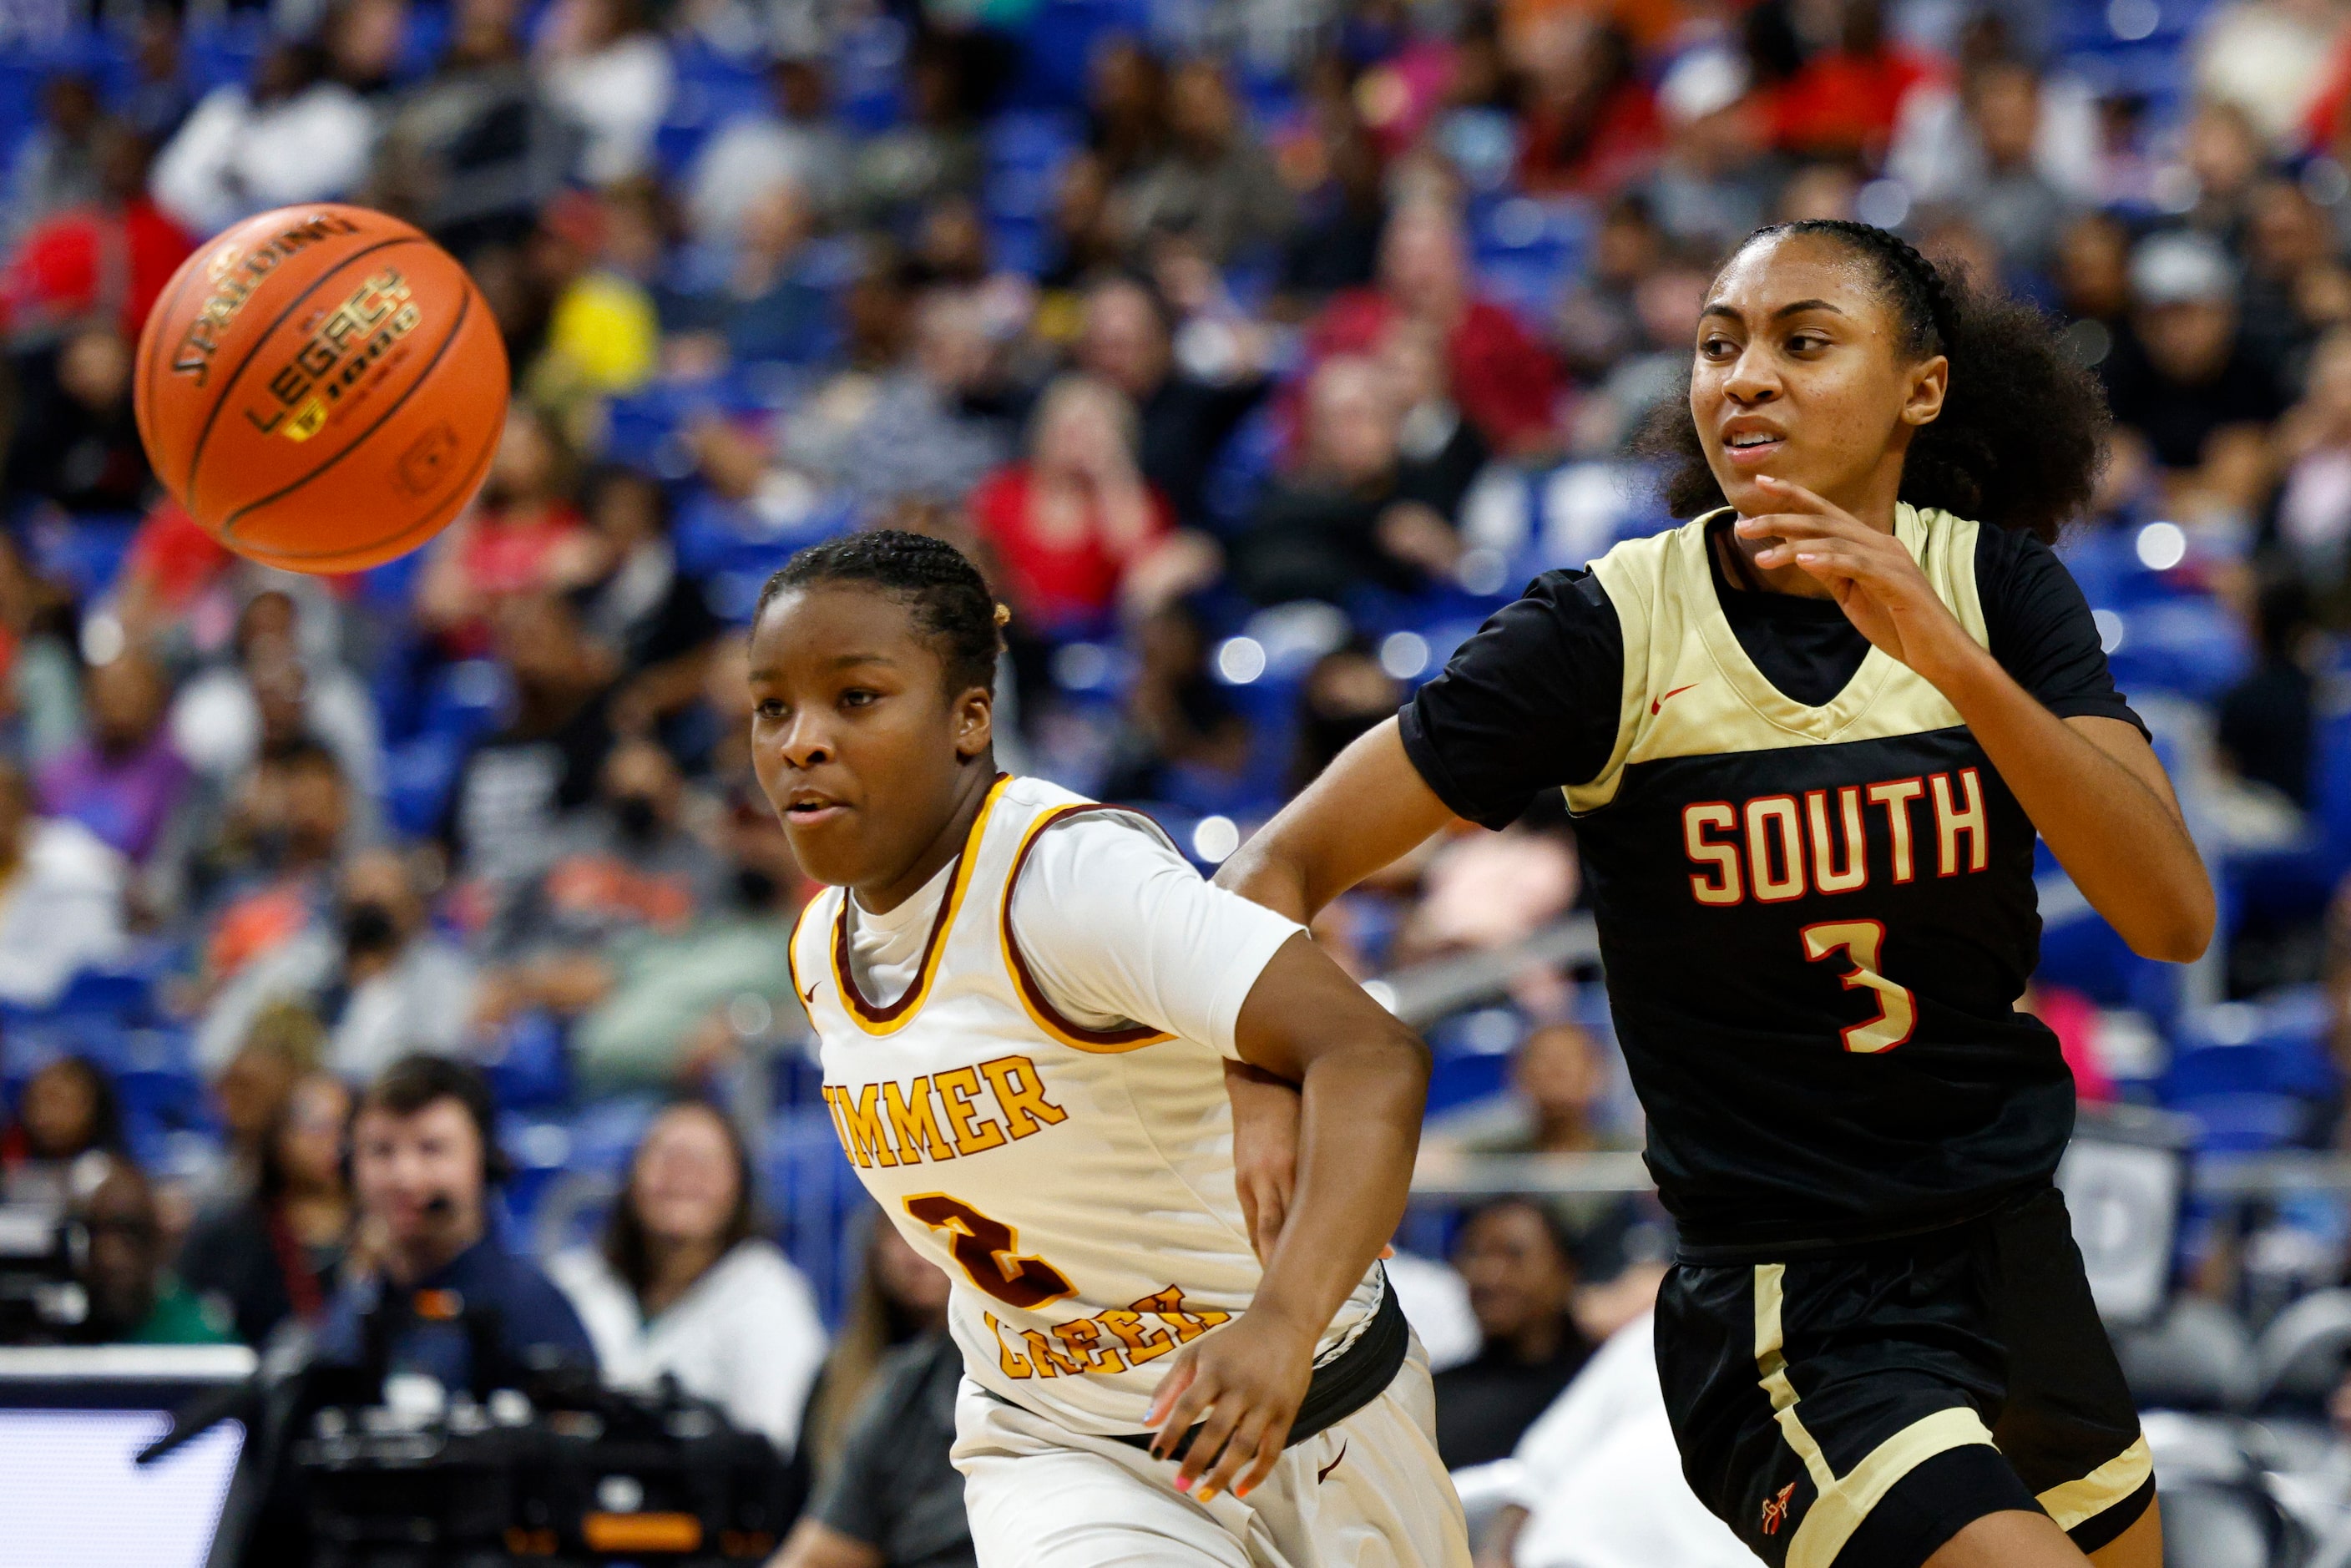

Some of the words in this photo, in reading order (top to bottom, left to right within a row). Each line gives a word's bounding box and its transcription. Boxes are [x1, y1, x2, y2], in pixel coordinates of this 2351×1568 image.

[244, 264, 412, 436] LEGACY
[1681, 766, 1989, 908] SOUTH
[1799, 918, 1918, 1054] 3
[902, 1191, 1079, 1310] 2
